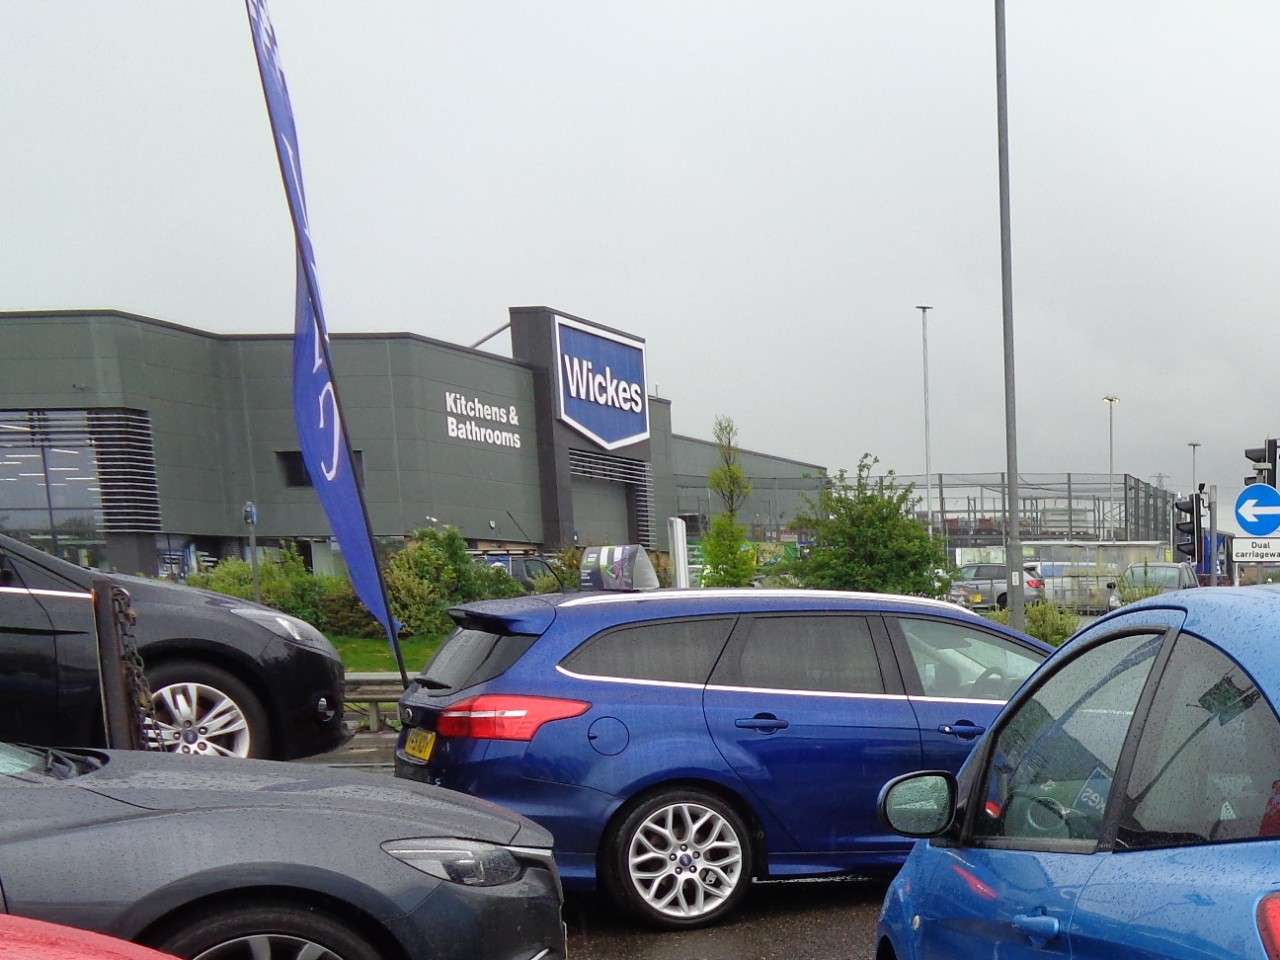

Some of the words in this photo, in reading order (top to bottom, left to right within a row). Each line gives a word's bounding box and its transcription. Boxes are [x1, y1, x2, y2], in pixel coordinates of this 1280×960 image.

[563, 354, 642, 413] Wickes
[445, 391, 507, 423] Kitchens
[509, 405, 519, 426] &
[447, 416, 521, 448] Bathrooms
[1251, 541, 1270, 549] Dual
